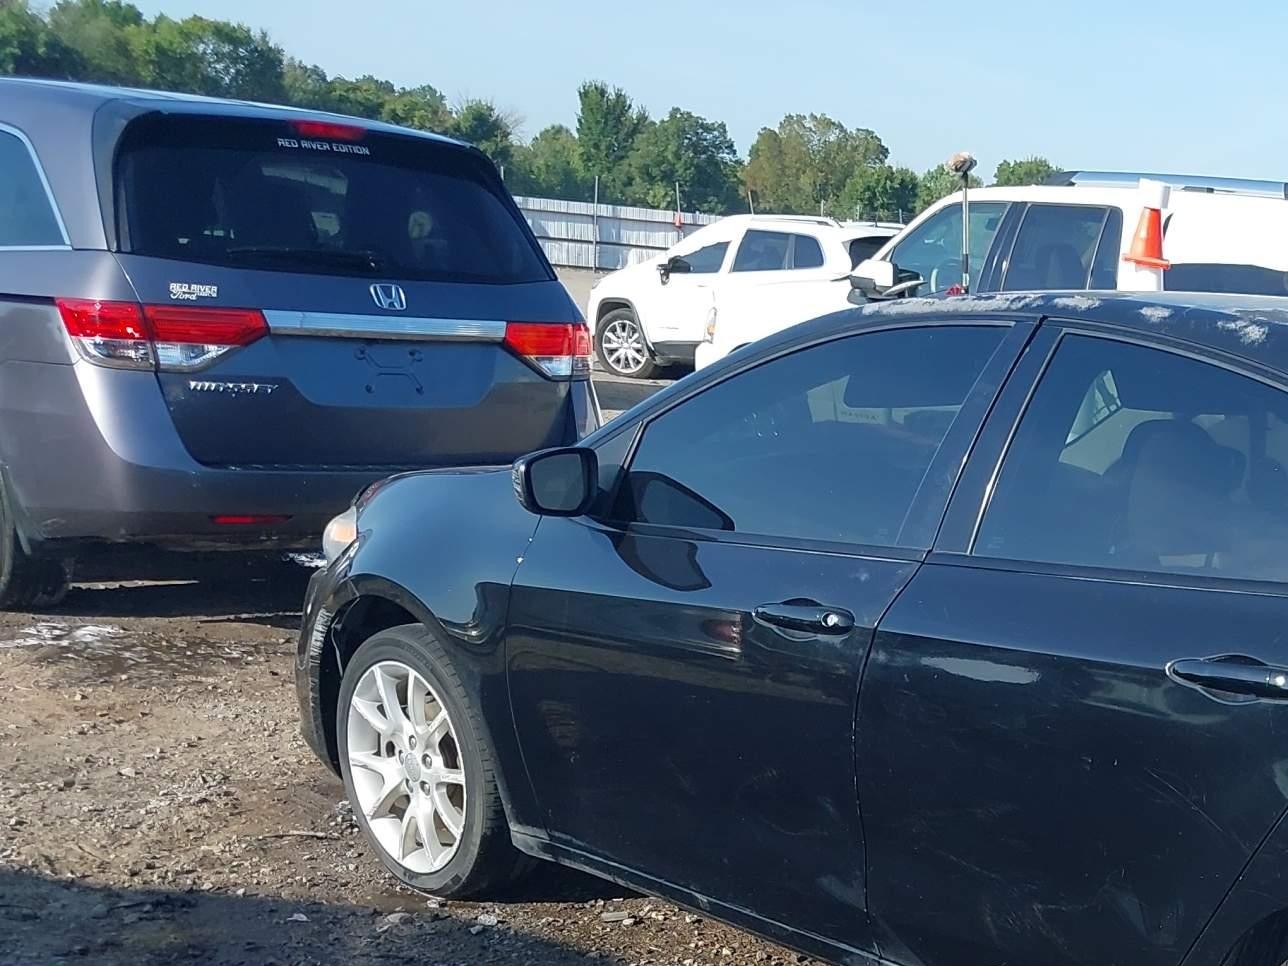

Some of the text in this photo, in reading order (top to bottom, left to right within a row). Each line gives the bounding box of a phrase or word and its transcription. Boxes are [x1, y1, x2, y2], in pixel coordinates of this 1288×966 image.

[277, 138, 370, 155] RED RIVER EDITION
[169, 283, 218, 294] RED RIVER
